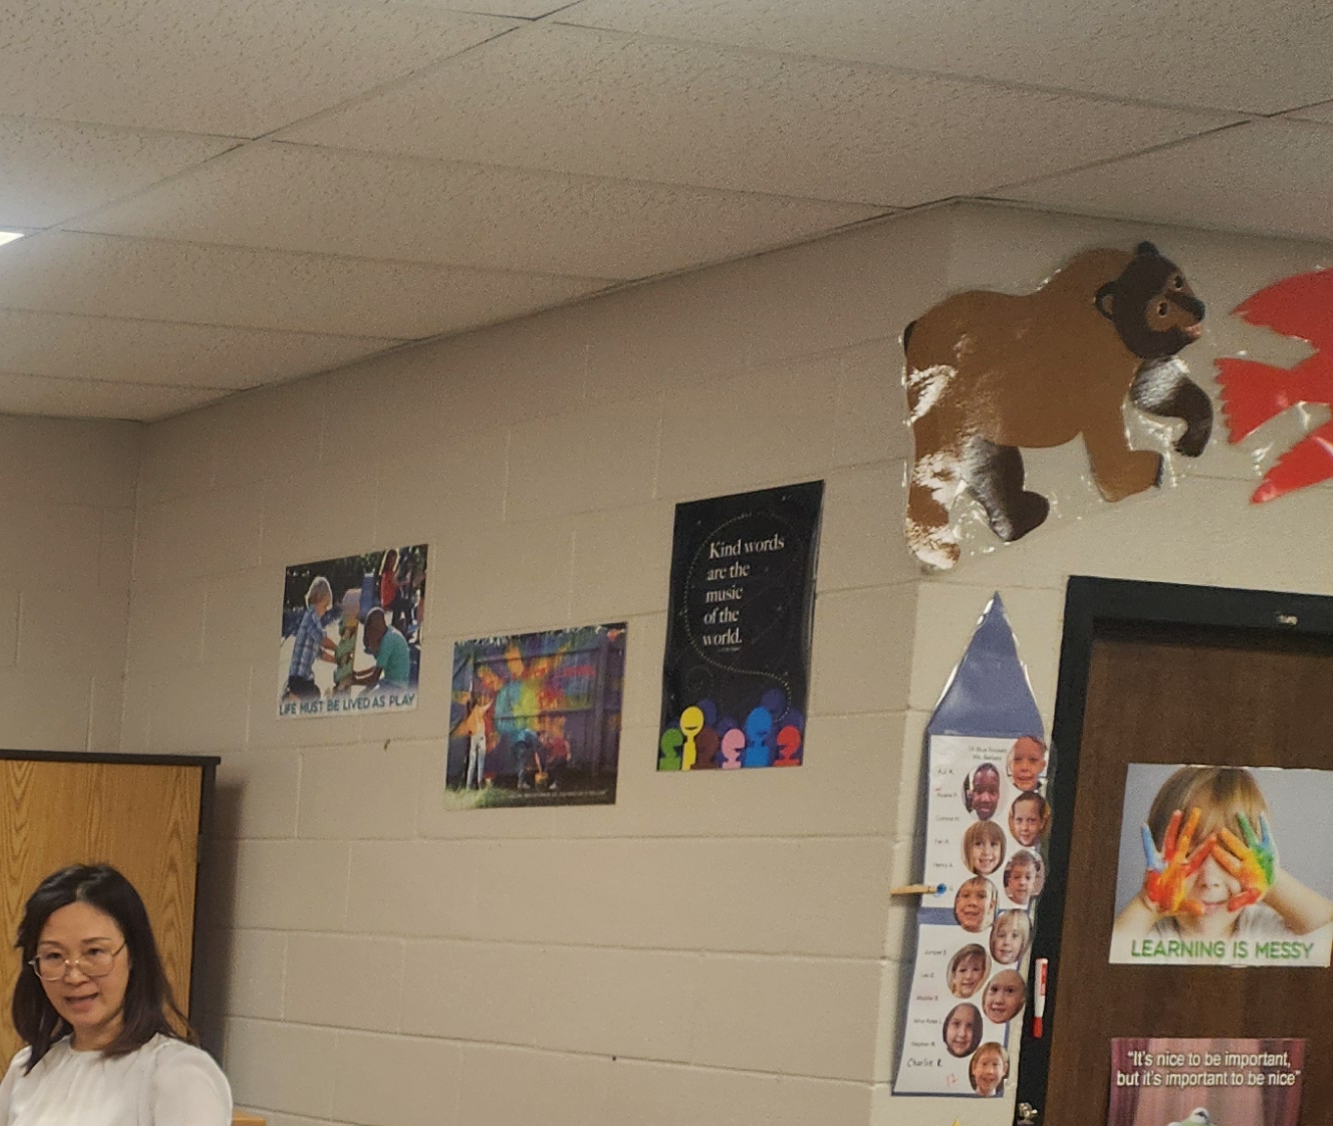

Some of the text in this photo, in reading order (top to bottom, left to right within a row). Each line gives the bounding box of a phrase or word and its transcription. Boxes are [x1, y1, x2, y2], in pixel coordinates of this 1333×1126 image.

[709, 533, 785, 559] Kind words
[707, 561, 751, 580] are the
[705, 584, 743, 603] music
[703, 606, 739, 624] of the
[703, 627, 743, 646] world.
[279, 693, 415, 716] LIFE MUST BE LIVED AS PLAY
[1131, 938, 1313, 960] LEARNING IS MESSY
[1127, 1051, 1291, 1070] "It's nice to be important,
[1117, 1070, 1301, 1089] but it's important to be nice"
